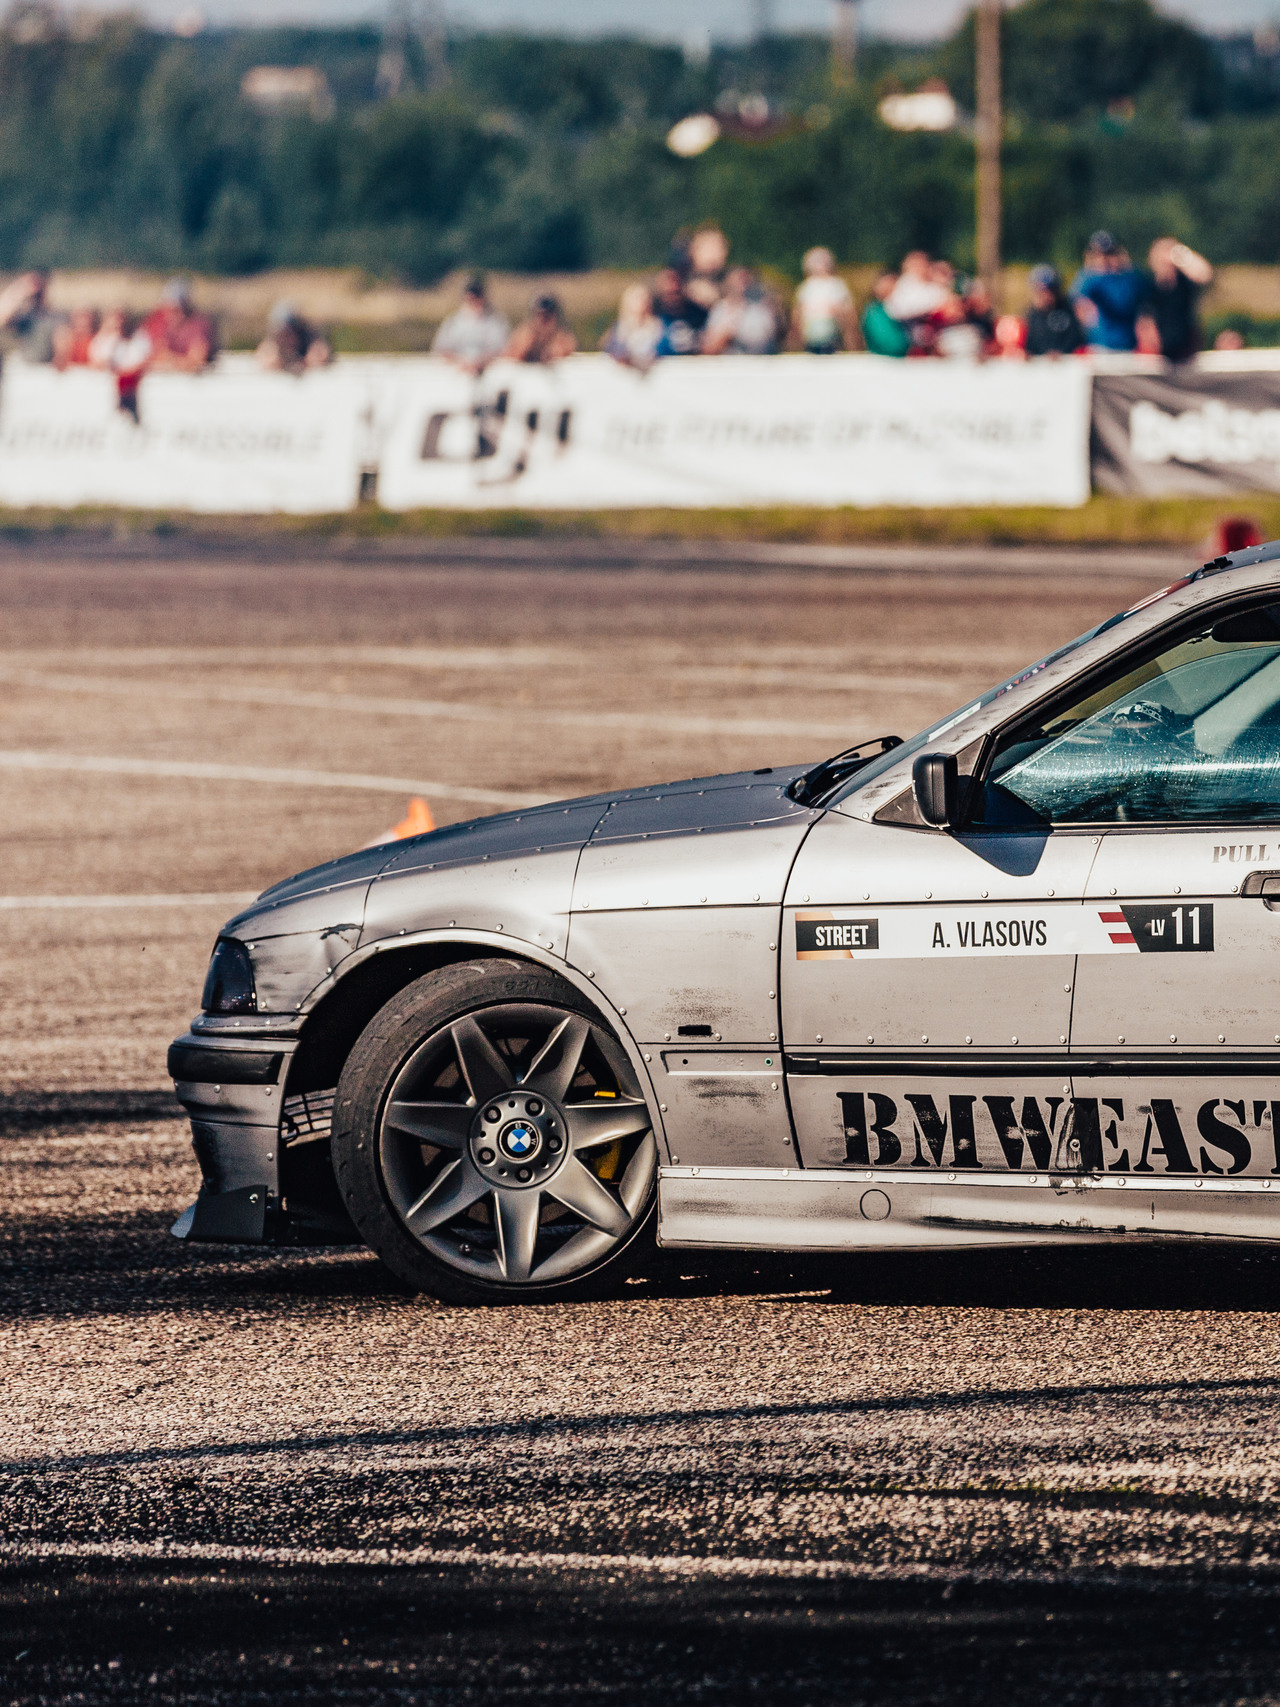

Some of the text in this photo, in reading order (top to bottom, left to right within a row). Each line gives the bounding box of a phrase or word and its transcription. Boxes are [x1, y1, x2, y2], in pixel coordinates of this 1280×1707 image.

[1211, 844, 1271, 863] PULL
[815, 925, 869, 947] STREET
[932, 920, 1048, 948] A. VLASOVS
[1151, 906, 1200, 945] LV 11
